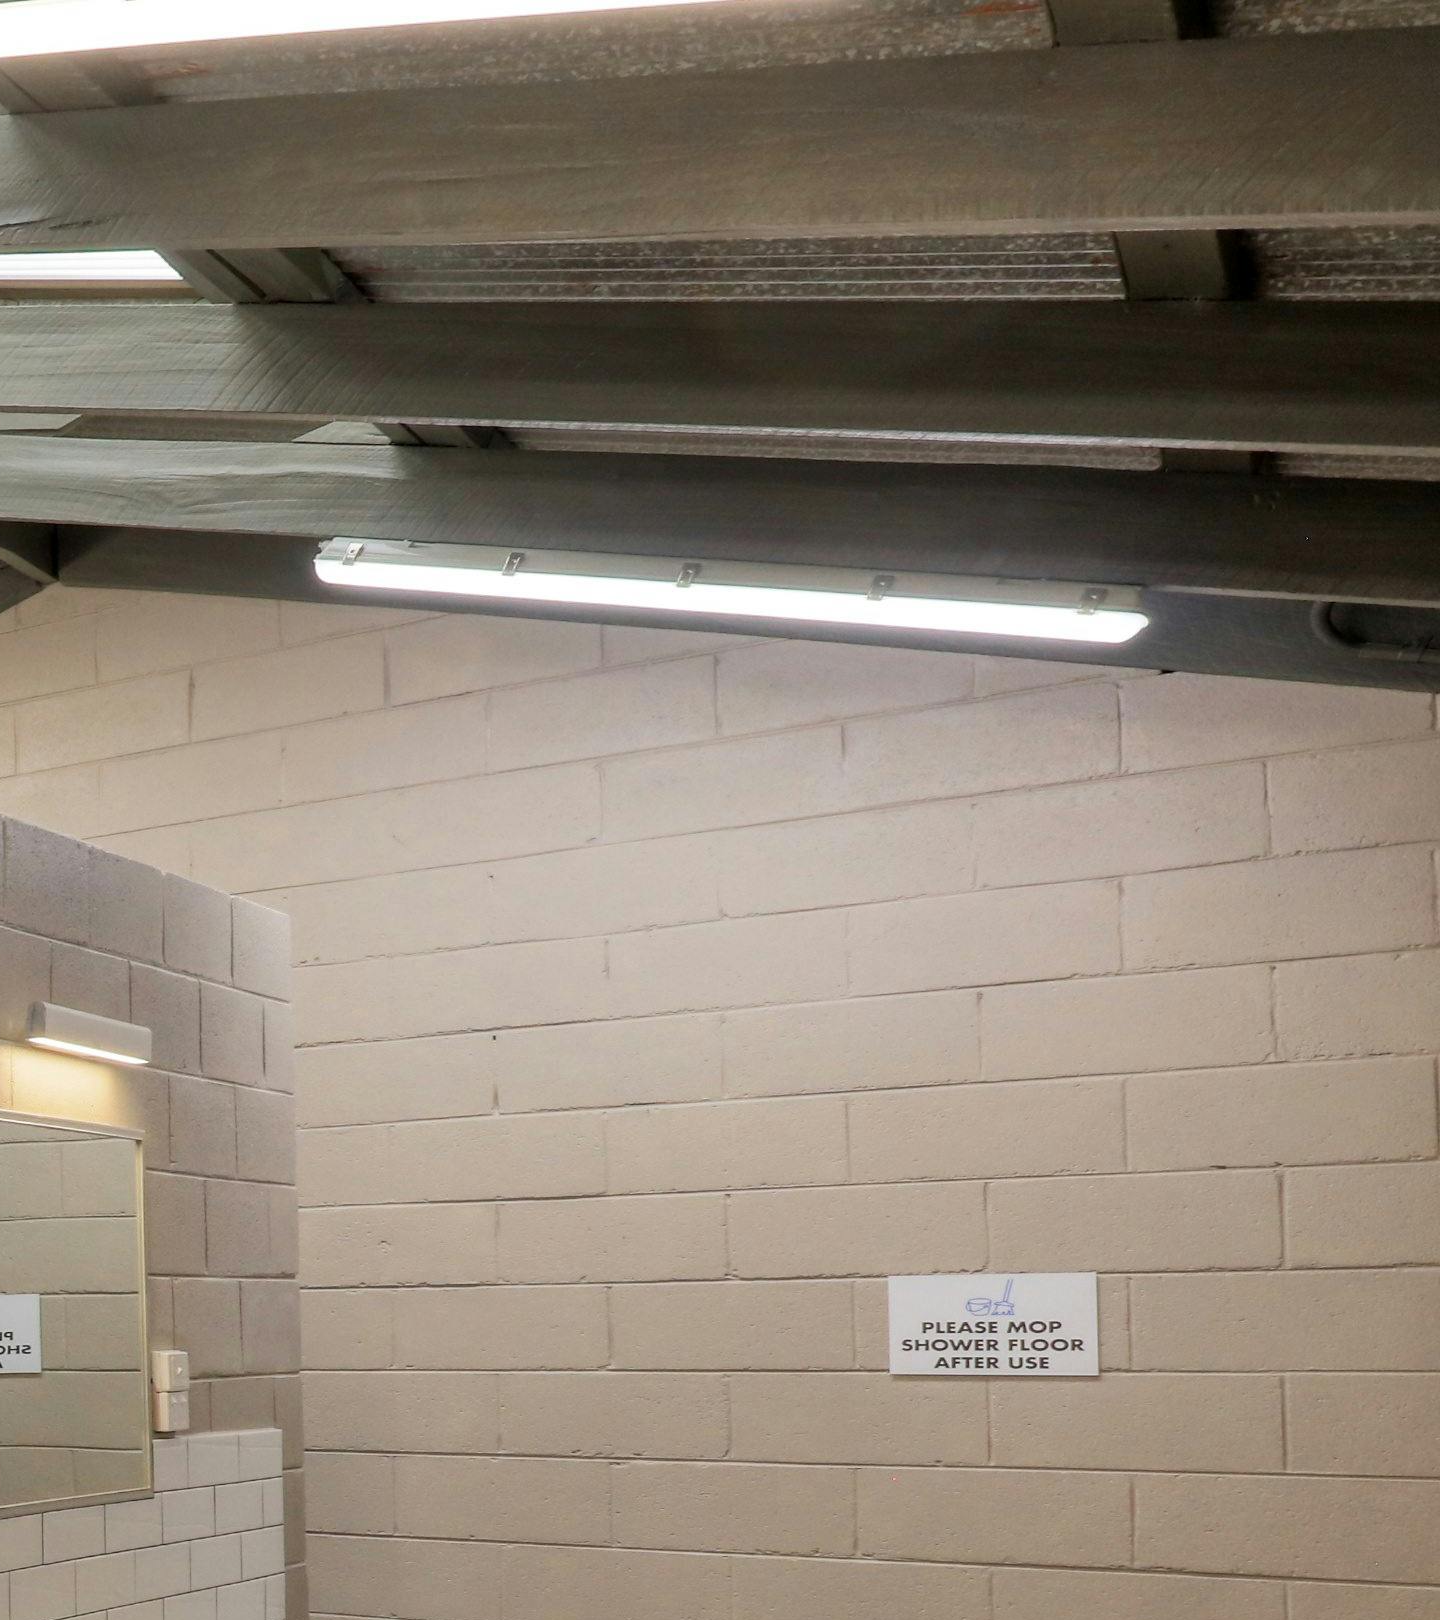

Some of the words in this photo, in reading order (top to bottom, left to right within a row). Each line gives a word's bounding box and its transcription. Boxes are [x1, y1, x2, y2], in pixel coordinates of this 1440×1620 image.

[921, 1321, 998, 1334] PLEASE
[1006, 1320, 1063, 1334] MOP
[901, 1338, 1000, 1352] SHOWER
[1008, 1338, 1085, 1352] FLOOR
[934, 1356, 1000, 1370] AFTER
[1008, 1356, 1050, 1370] USE
